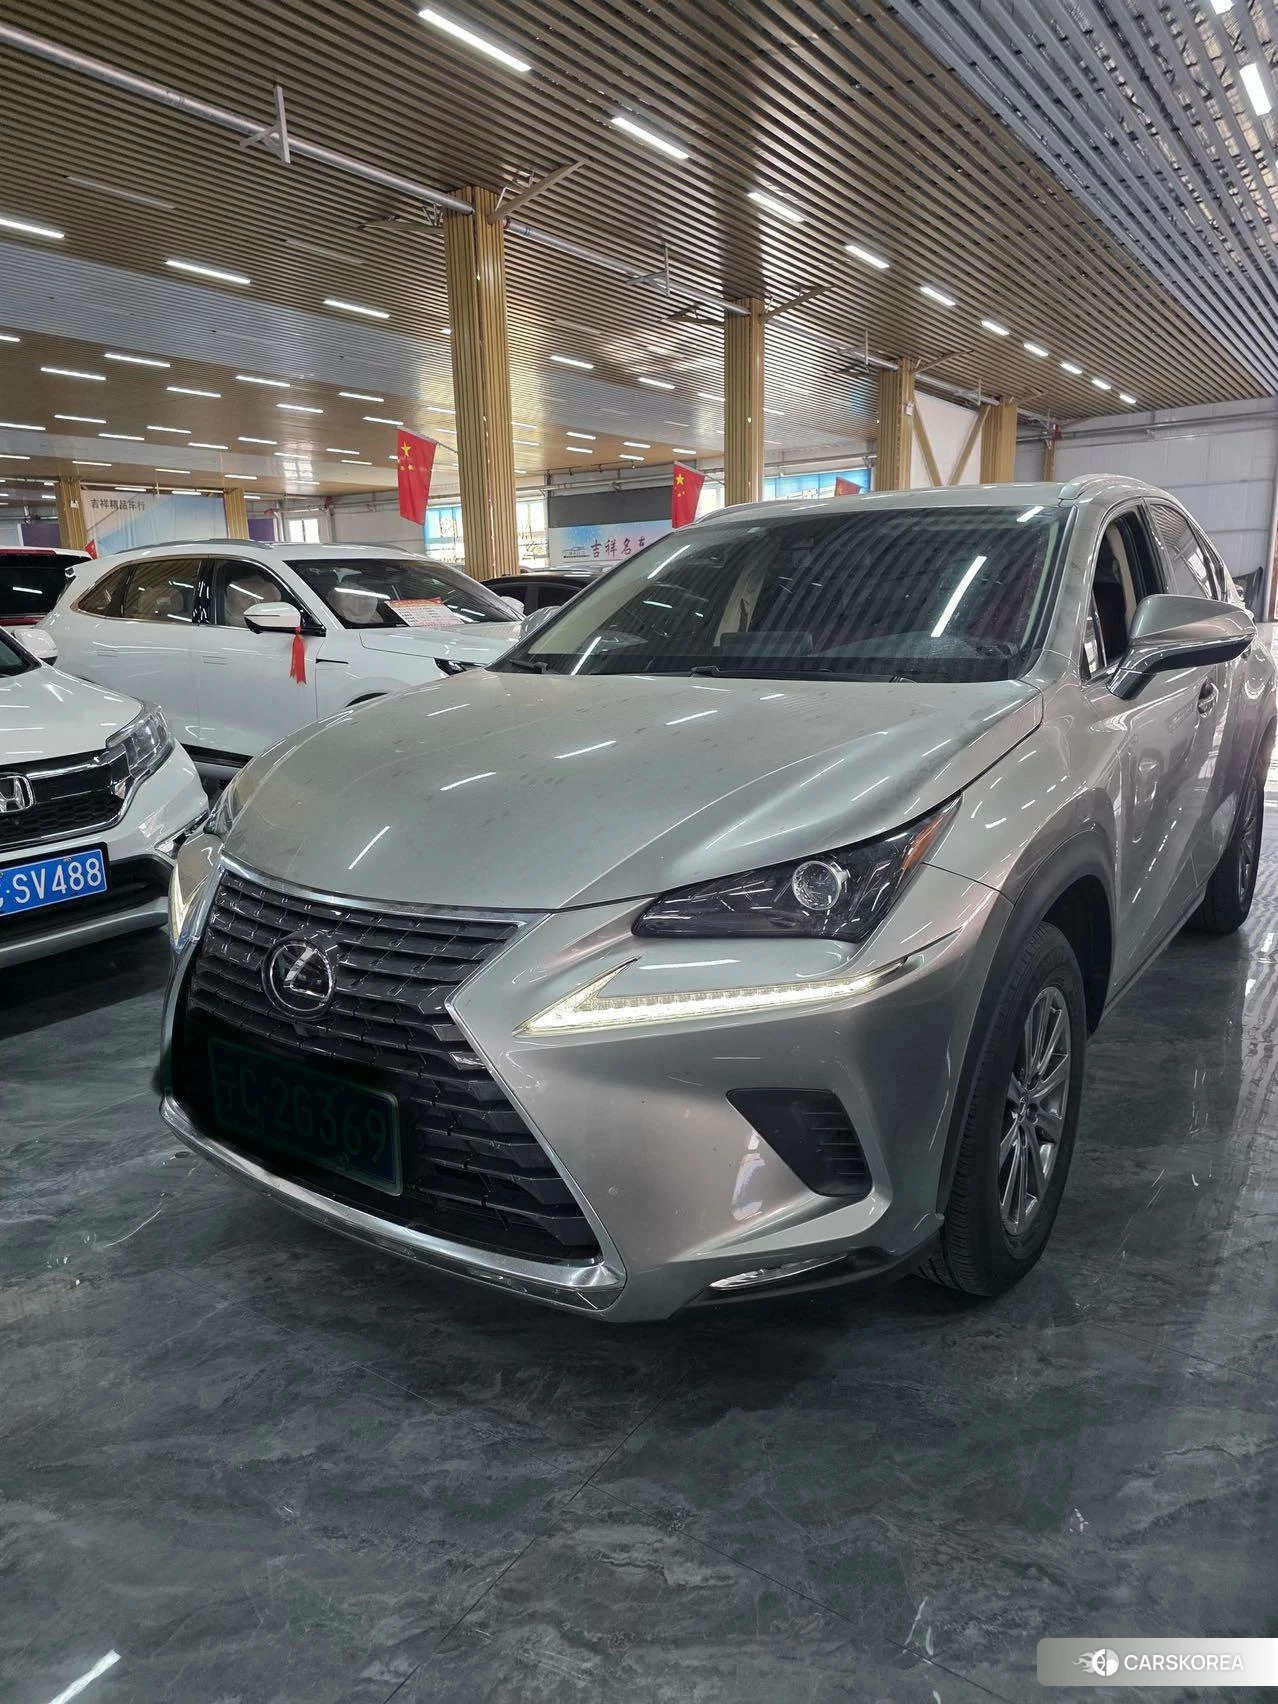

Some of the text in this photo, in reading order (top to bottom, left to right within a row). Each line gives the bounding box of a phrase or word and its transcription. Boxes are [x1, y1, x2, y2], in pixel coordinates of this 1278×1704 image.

[90, 498, 146, 511] 吉祥精品车行
